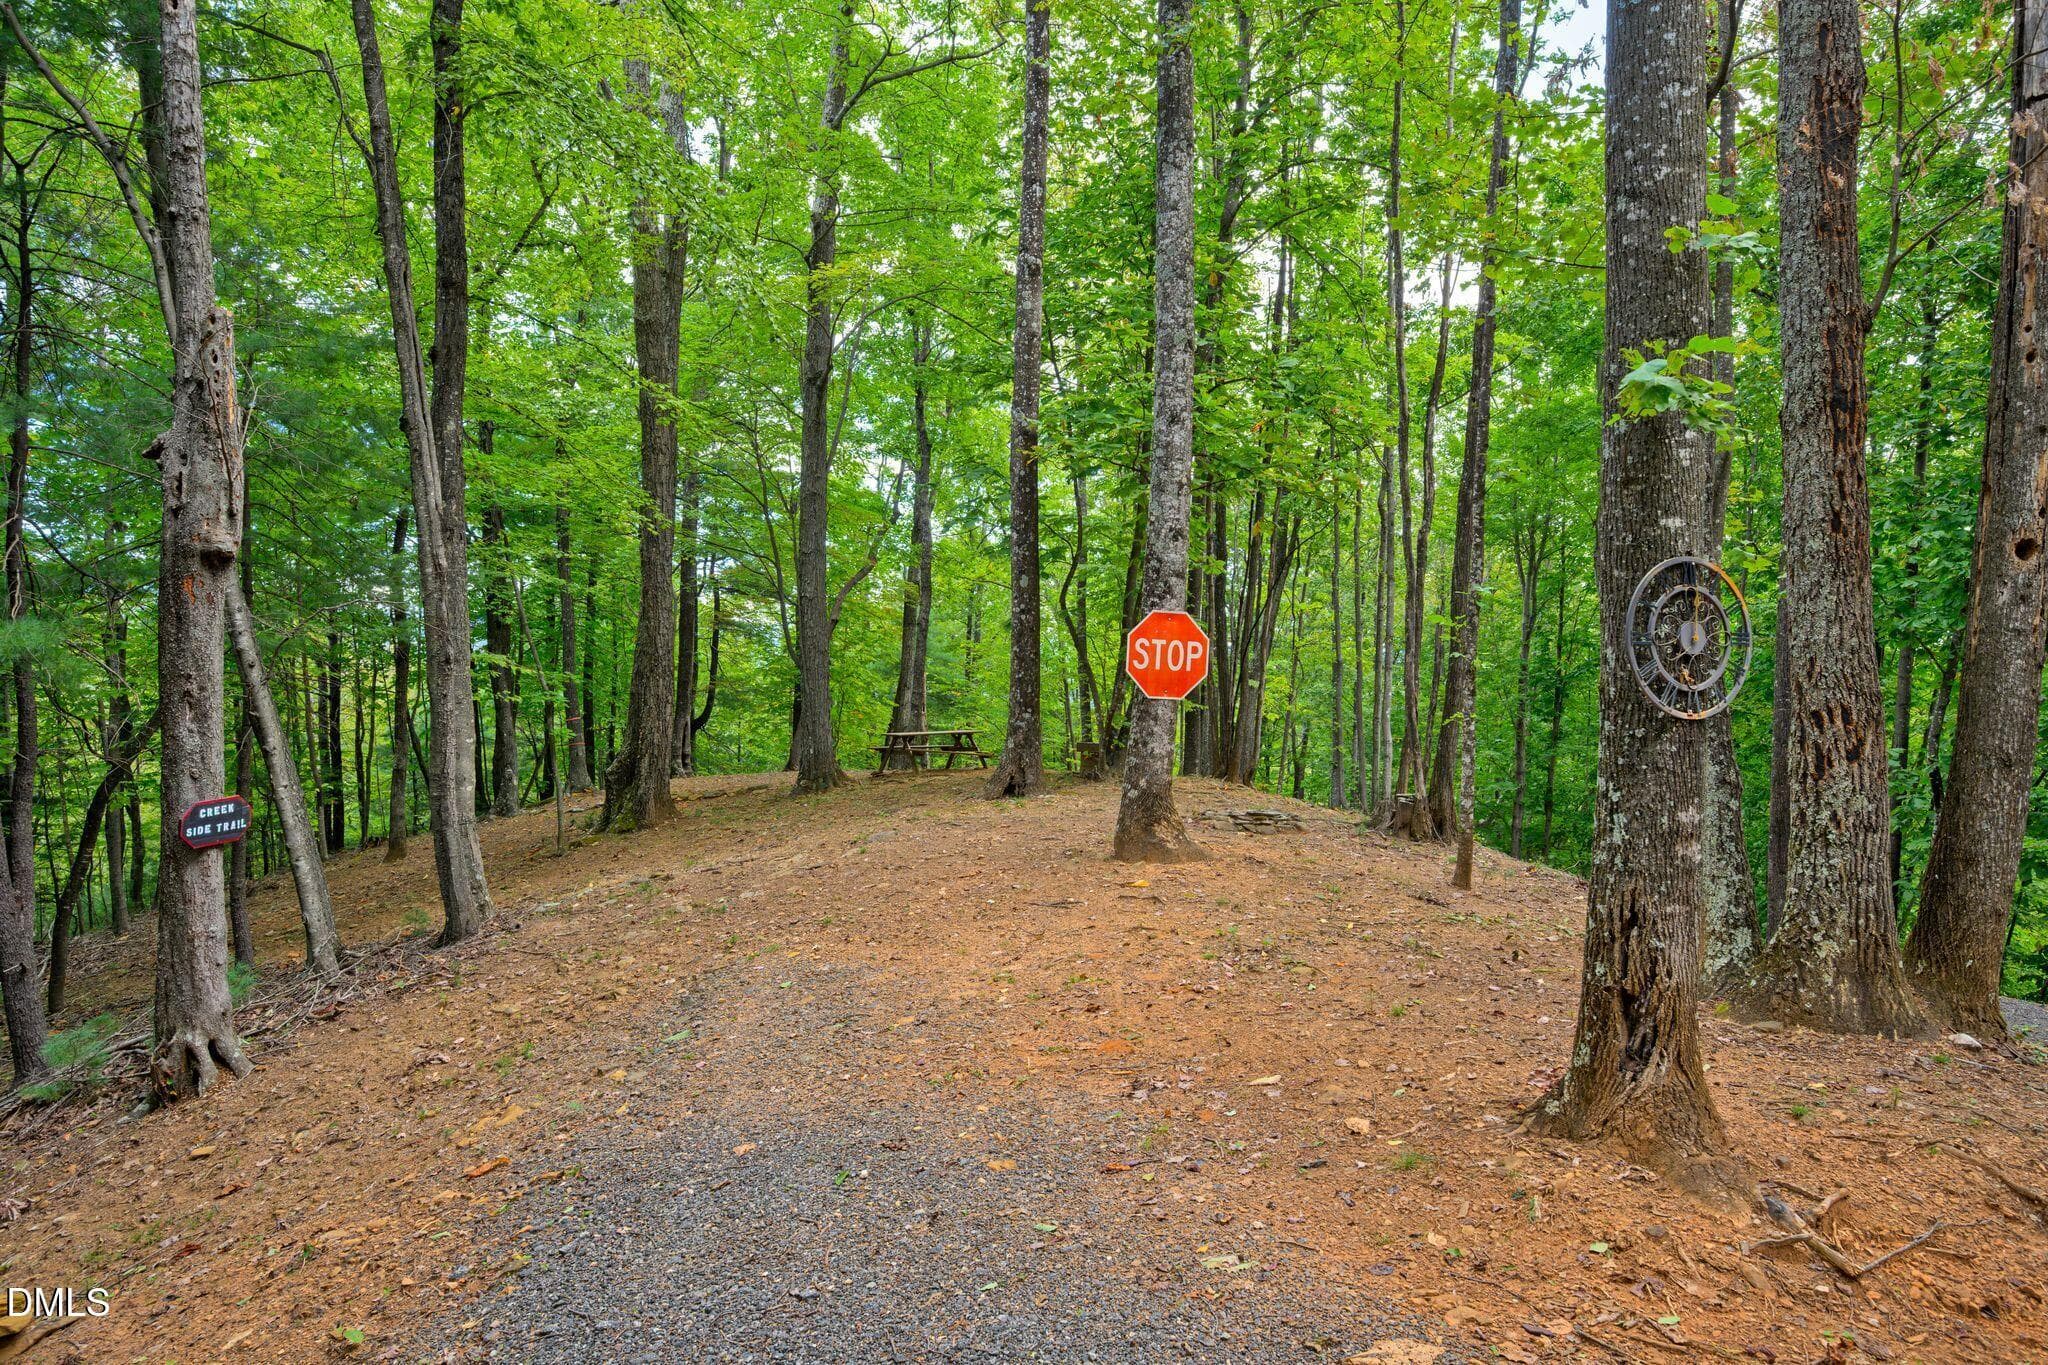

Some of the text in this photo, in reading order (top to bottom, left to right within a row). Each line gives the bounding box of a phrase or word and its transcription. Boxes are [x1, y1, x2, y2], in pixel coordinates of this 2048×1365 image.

[1133, 638, 1203, 672] STOP
[199, 803, 234, 818] CREEK
[186, 818, 246, 837] SIDE TRAIL
